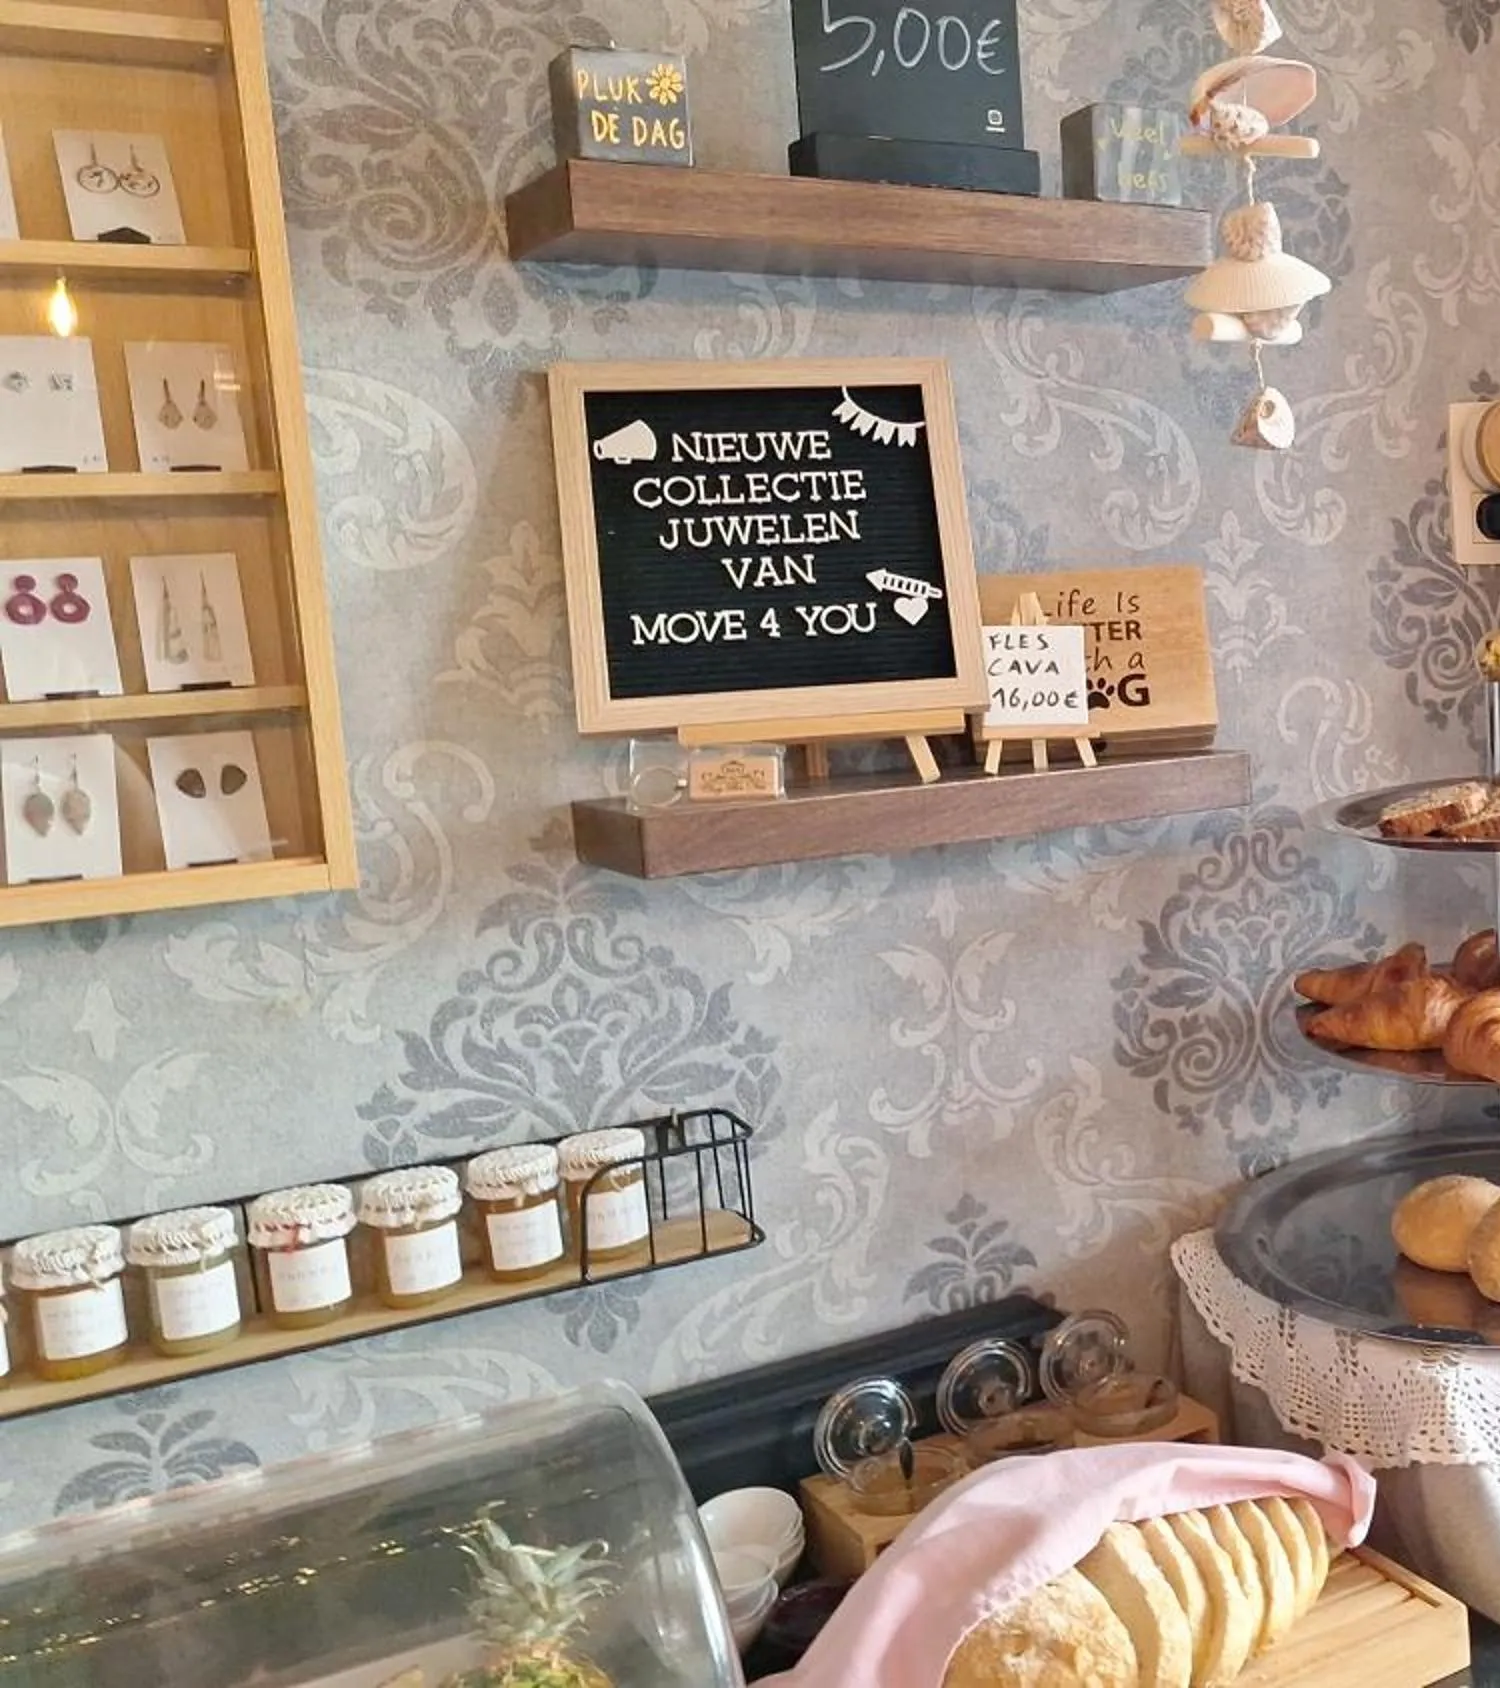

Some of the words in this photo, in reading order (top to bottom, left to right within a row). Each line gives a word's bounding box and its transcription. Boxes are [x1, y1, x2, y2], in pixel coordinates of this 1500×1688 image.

[819, 0, 1005, 77] 5,00€
[577, 68, 643, 104] PLUK
[591, 110, 621, 144] DE
[632, 116, 685, 149] DAG
[671, 430, 831, 464] NIEUWE
[632, 470, 867, 508] COLLECTIE
[659, 510, 861, 550] JUWELEN
[722, 554, 817, 589] VAN
[630, 609, 748, 646] MOVE
[760, 607, 781, 638] 4
[796, 602, 878, 638] YOU
[1084, 619, 1143, 642] TER
[989, 633, 1049, 651] FLES
[987, 658, 1060, 676] CAVA
[1128, 651, 1145, 670] a
[992, 687, 1079, 712] 16,00€
